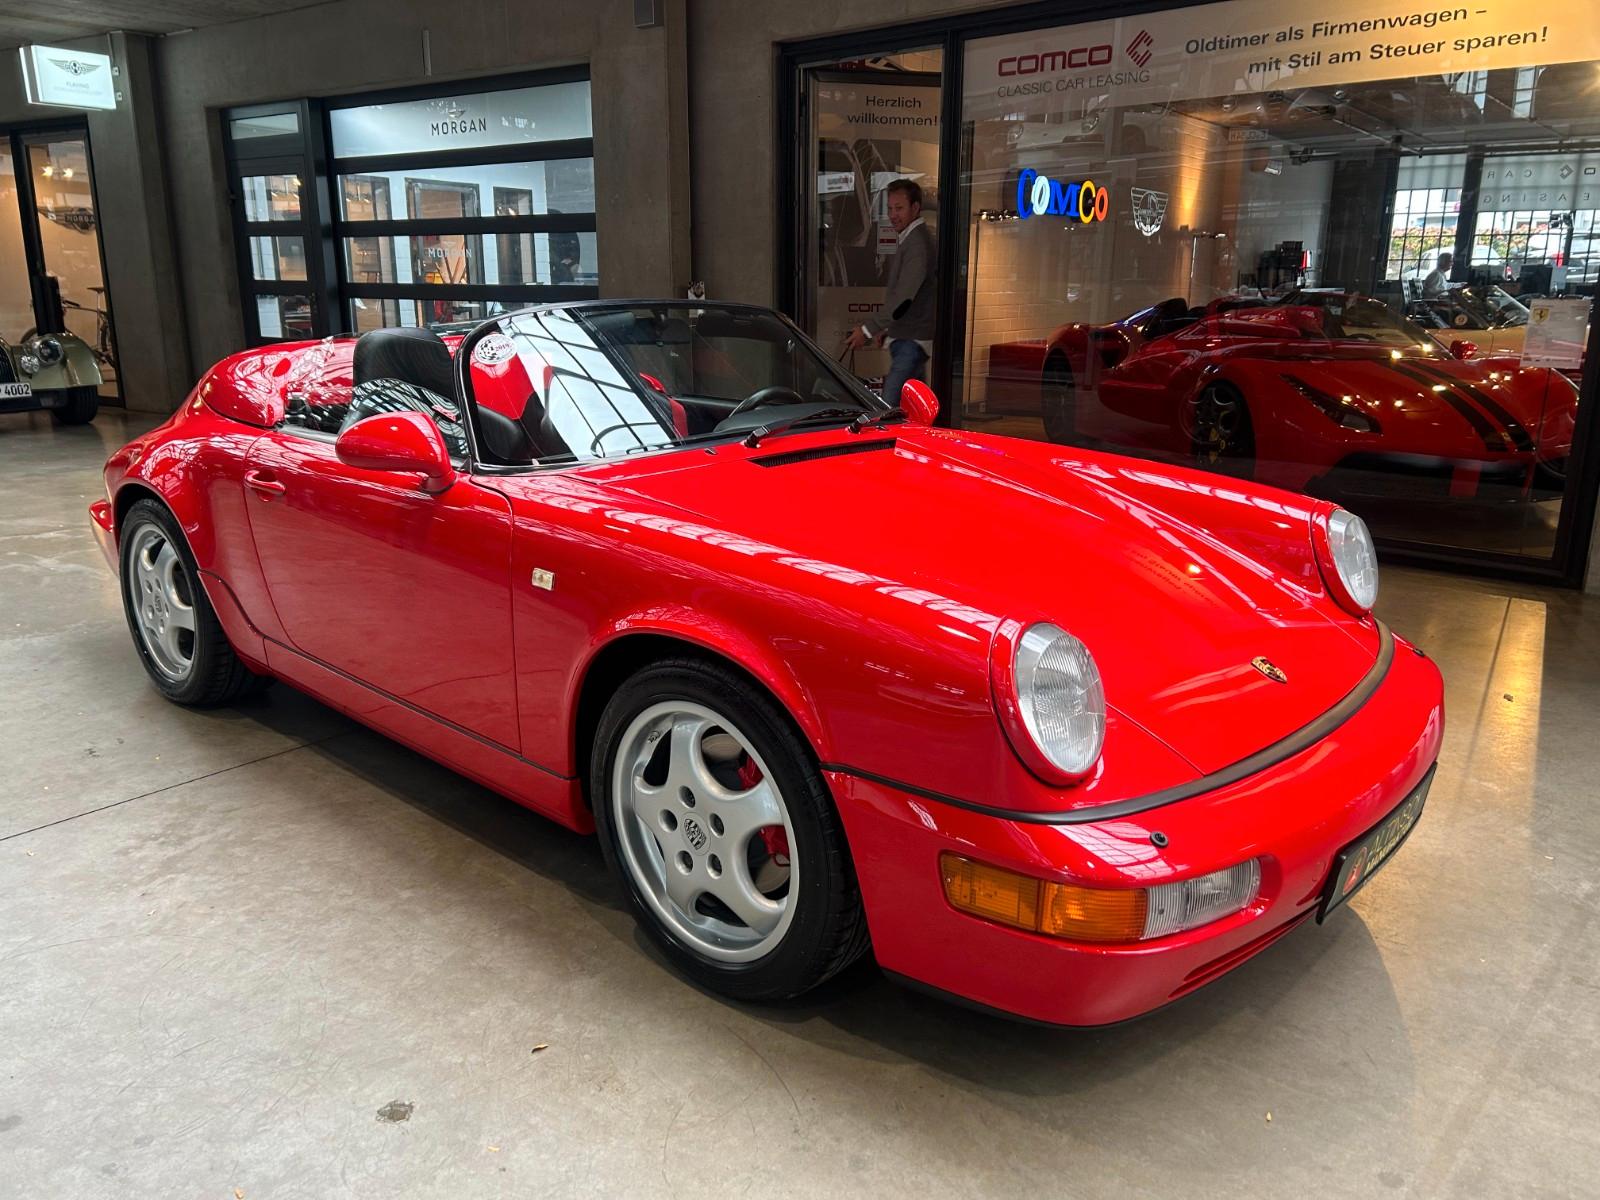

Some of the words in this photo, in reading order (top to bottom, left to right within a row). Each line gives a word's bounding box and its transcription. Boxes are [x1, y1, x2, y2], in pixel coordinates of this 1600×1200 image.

[1185, 32, 1269, 54] Oldtimer
[1275, 26, 1304, 43] als
[1312, 8, 1467, 38] Firmenwagen
[1248, 56, 1282, 74] mit
[1288, 51, 1321, 70] Stil
[1328, 50, 1361, 65] am
[1370, 40, 1445, 60] Steuer
[1453, 26, 1548, 53] sparen!
[997, 80, 1051, 97] CLASSIC
[1055, 77, 1084, 91] CAR
[1088, 70, 1150, 88] LEASING
[865, 95, 922, 109] Herzlich
[431, 118, 487, 136] MORGAN
[847, 112, 938, 127] willkommen!
[428, 247, 472, 258] MORN
[5, 384, 30, 396] 4002
